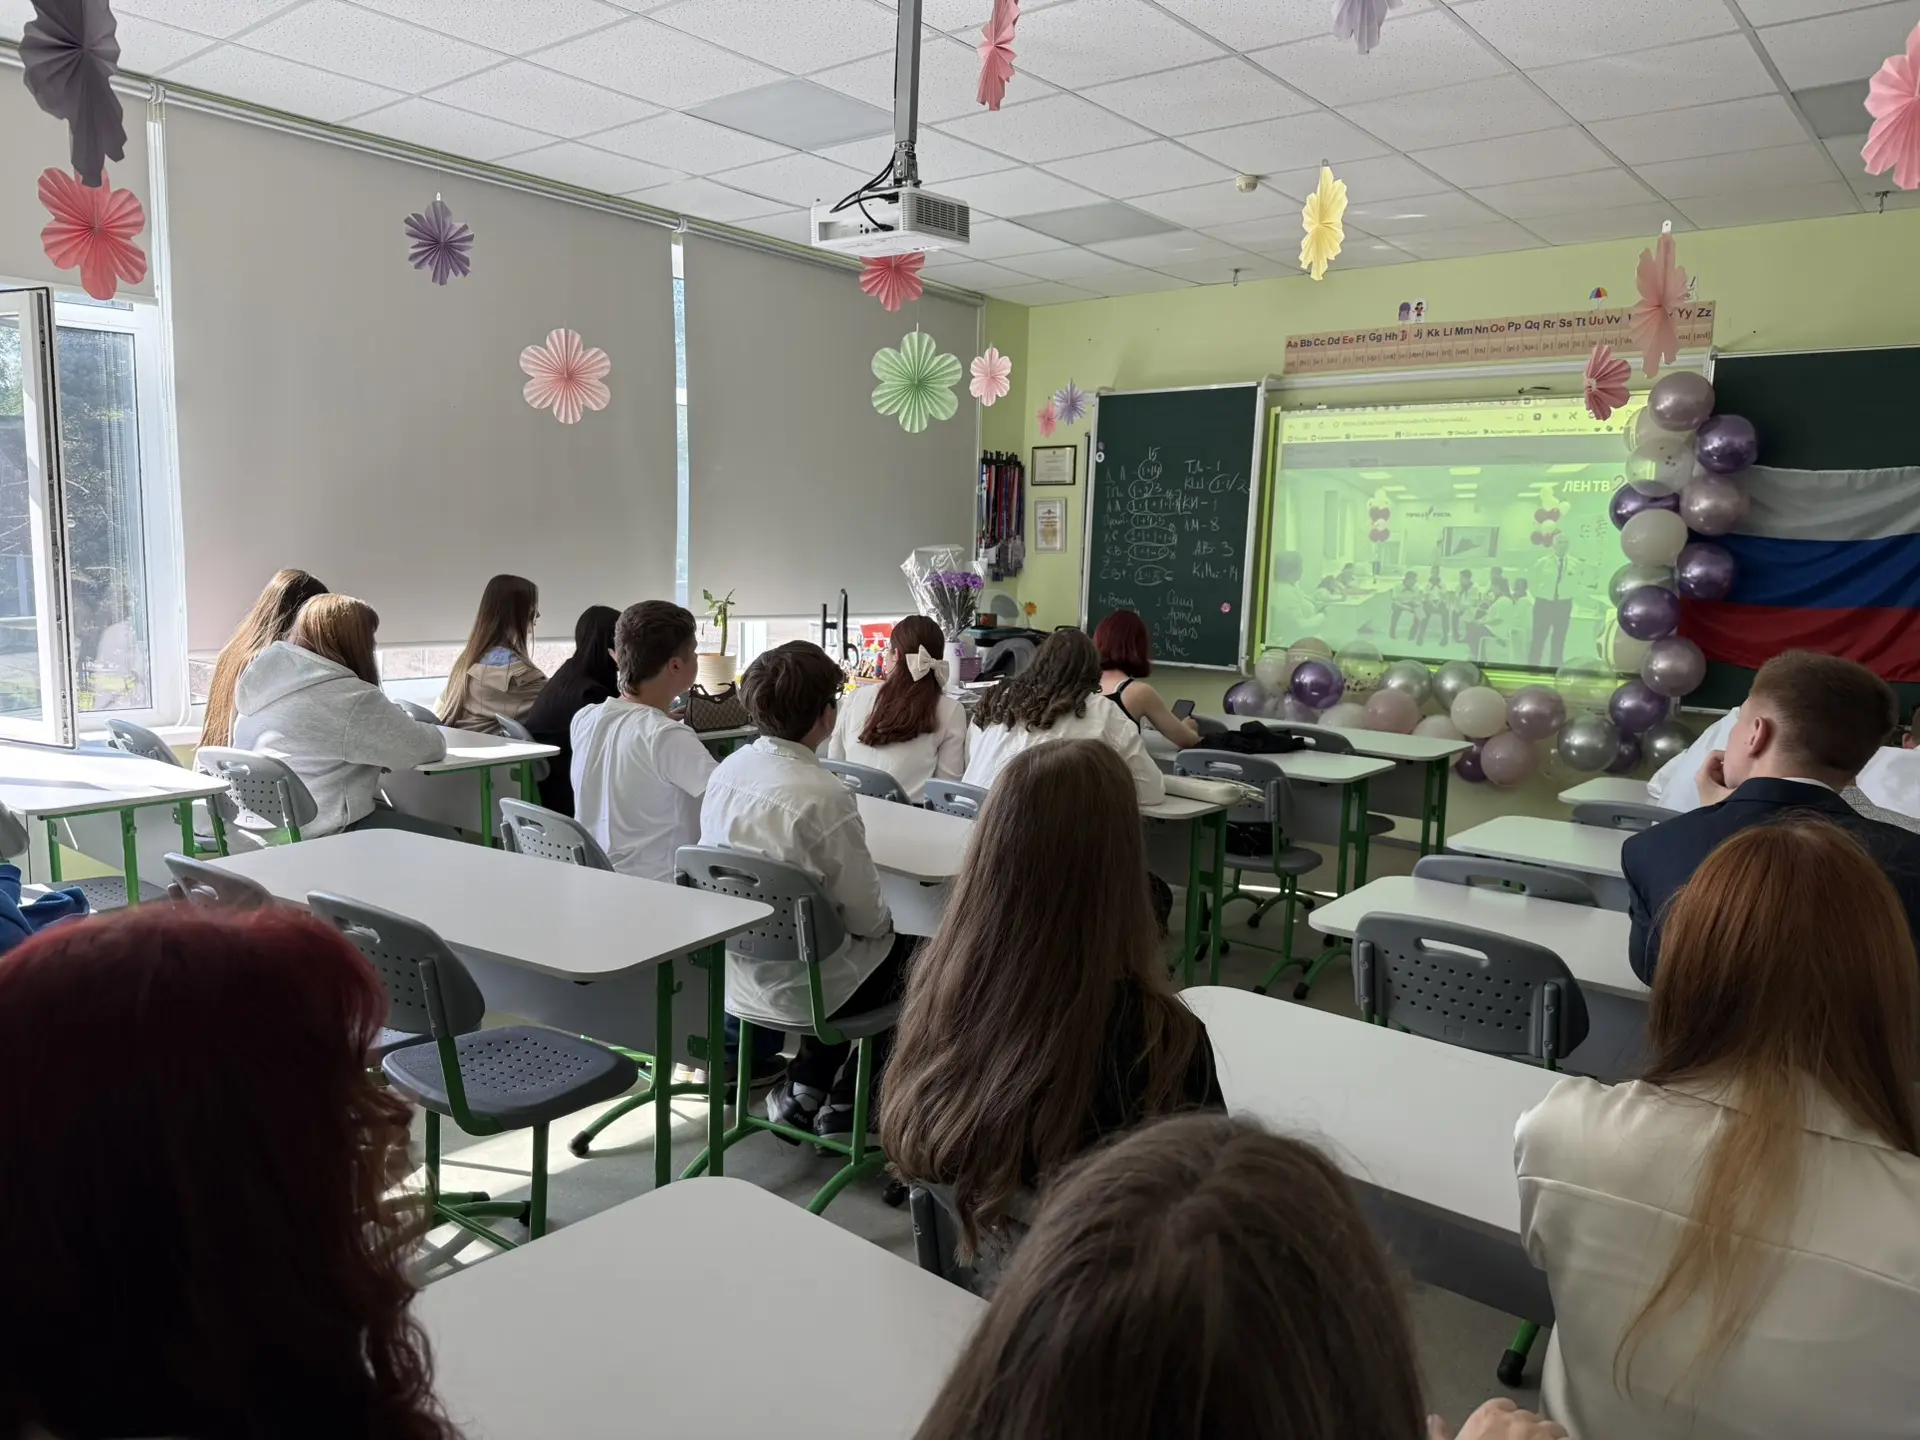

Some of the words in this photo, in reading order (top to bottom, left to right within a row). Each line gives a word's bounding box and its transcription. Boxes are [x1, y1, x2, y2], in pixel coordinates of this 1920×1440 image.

[1286, 340, 1298, 348] Aa
[1300, 338, 1313, 348] Bb
[1314, 338, 1326, 347] Cc
[1327, 336, 1340, 346] Dd
[1342, 335, 1354, 344] Ee
[1356, 334, 1366, 343] Ff
[1368, 332, 1382, 344] Gg
[1384, 332, 1398, 341] Hh
[1414, 328, 1423, 340] Jj
[1427, 328, 1440, 338] Kk
[1443, 327, 1453, 336] Ll
[1454, 326, 1472, 336] Mm
[1474, 325, 1488, 334] Nn
[1490, 324, 1505, 333] Oo
[1507, 321, 1522, 332] Pp
[1524, 320, 1540, 332] Qq
[1543, 319, 1556, 329] Rr
[1558, 318, 1573, 328] Ss
[1575, 317, 1586, 327] Tt
[1588, 316, 1604, 326] Uu
[1606, 314, 1621, 325] Vv
[1678, 308, 1692, 320] Yy
[1696, 308, 1712, 318] Zz
[1210, 516, 1220, 532] 8
[1220, 541, 1234, 558] 3
